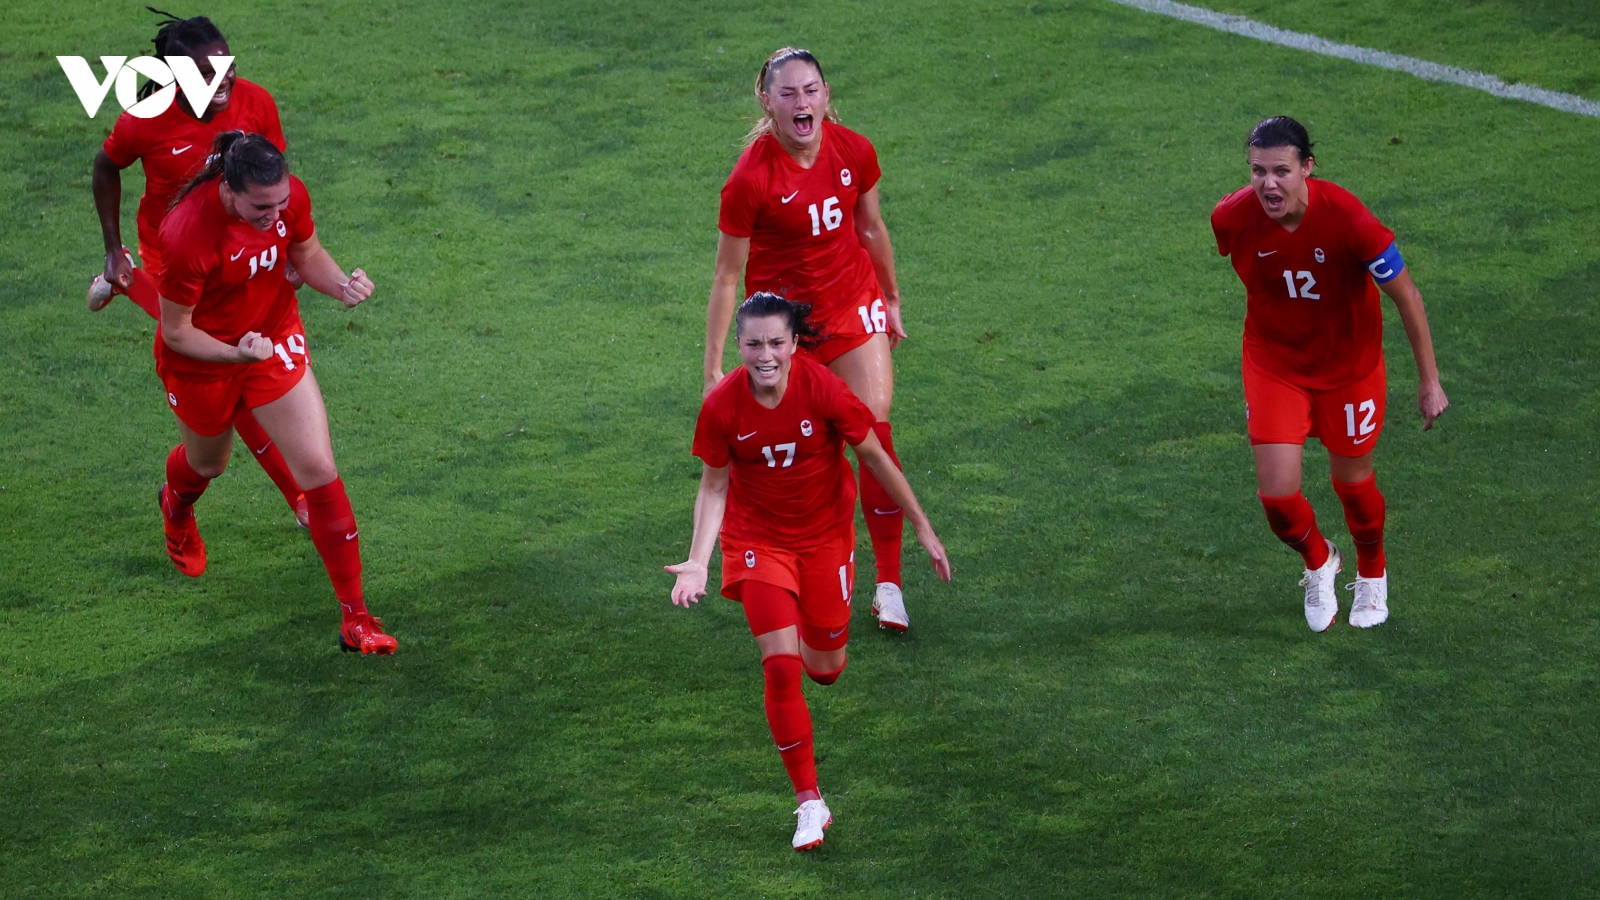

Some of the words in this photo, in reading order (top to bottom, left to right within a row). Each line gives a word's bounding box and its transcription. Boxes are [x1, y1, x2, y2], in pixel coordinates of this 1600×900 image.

[807, 197, 842, 236] 16
[248, 245, 278, 279] 14
[1368, 258, 1394, 280] C
[1283, 270, 1321, 300] 12
[858, 298, 887, 333] 16
[1344, 399, 1377, 437] 12
[761, 442, 796, 468] 17
[838, 551, 854, 601] 1
